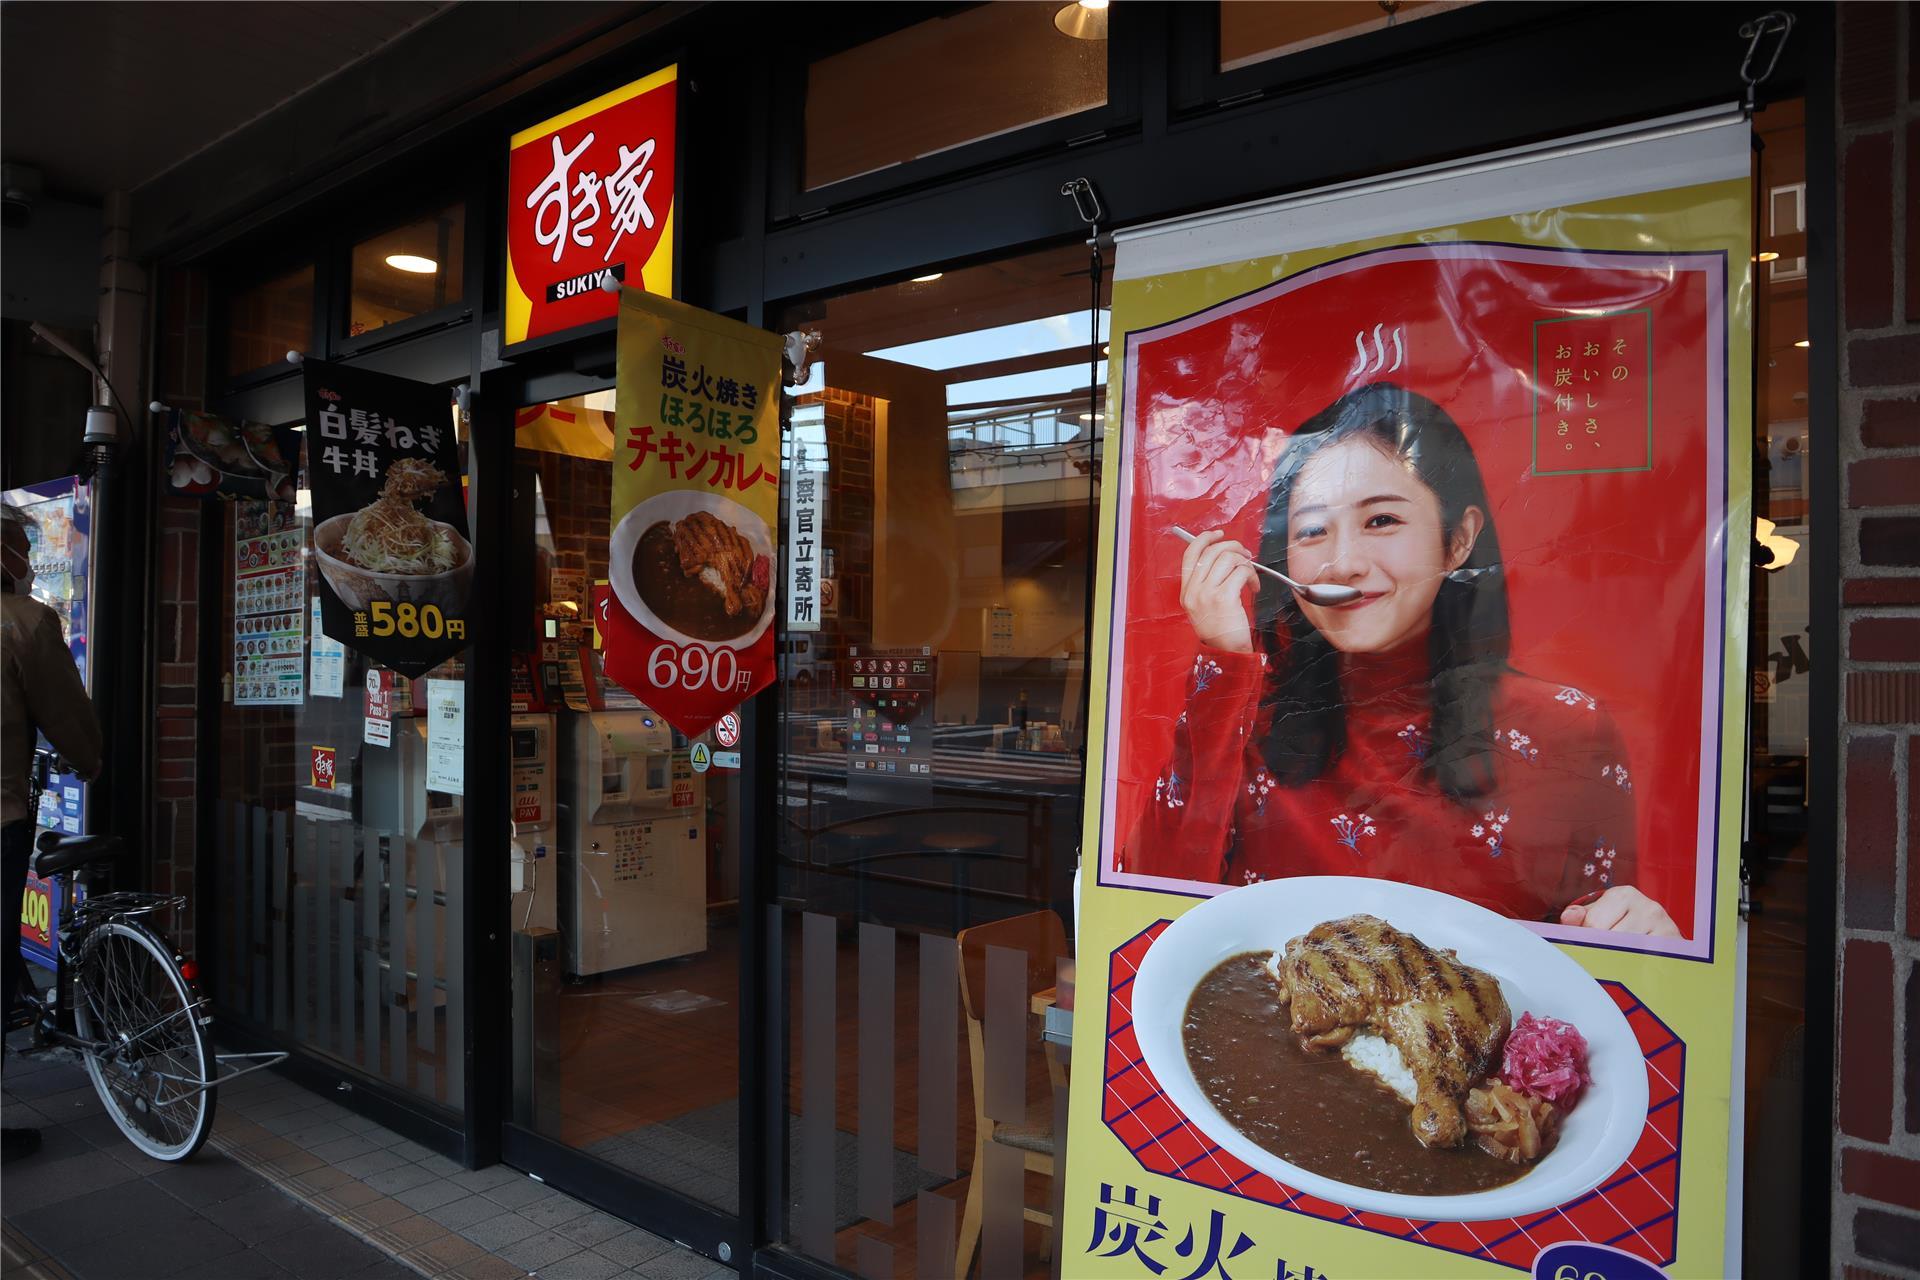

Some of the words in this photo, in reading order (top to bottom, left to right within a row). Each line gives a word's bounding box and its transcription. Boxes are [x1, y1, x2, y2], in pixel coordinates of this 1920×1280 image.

[526, 131, 656, 263] すき家
[661, 355, 759, 410] 炭火焼き
[1611, 338, 1629, 381] その
[659, 392, 760, 446] ほろほろ
[1554, 344, 1574, 451] お炭付き。
[1583, 341, 1601, 448] おいしさ、
[318, 403, 444, 454] 白髪ねぎ
[321, 446, 379, 479] 牛丼
[626, 424, 778, 492] チキンカレー
[353, 611, 369, 638] 並盛
[370, 601, 465, 641] 580円
[646, 643, 752, 695] 690円
[314, 750, 333, 778] すき家
[519, 807, 537, 818] PAY
